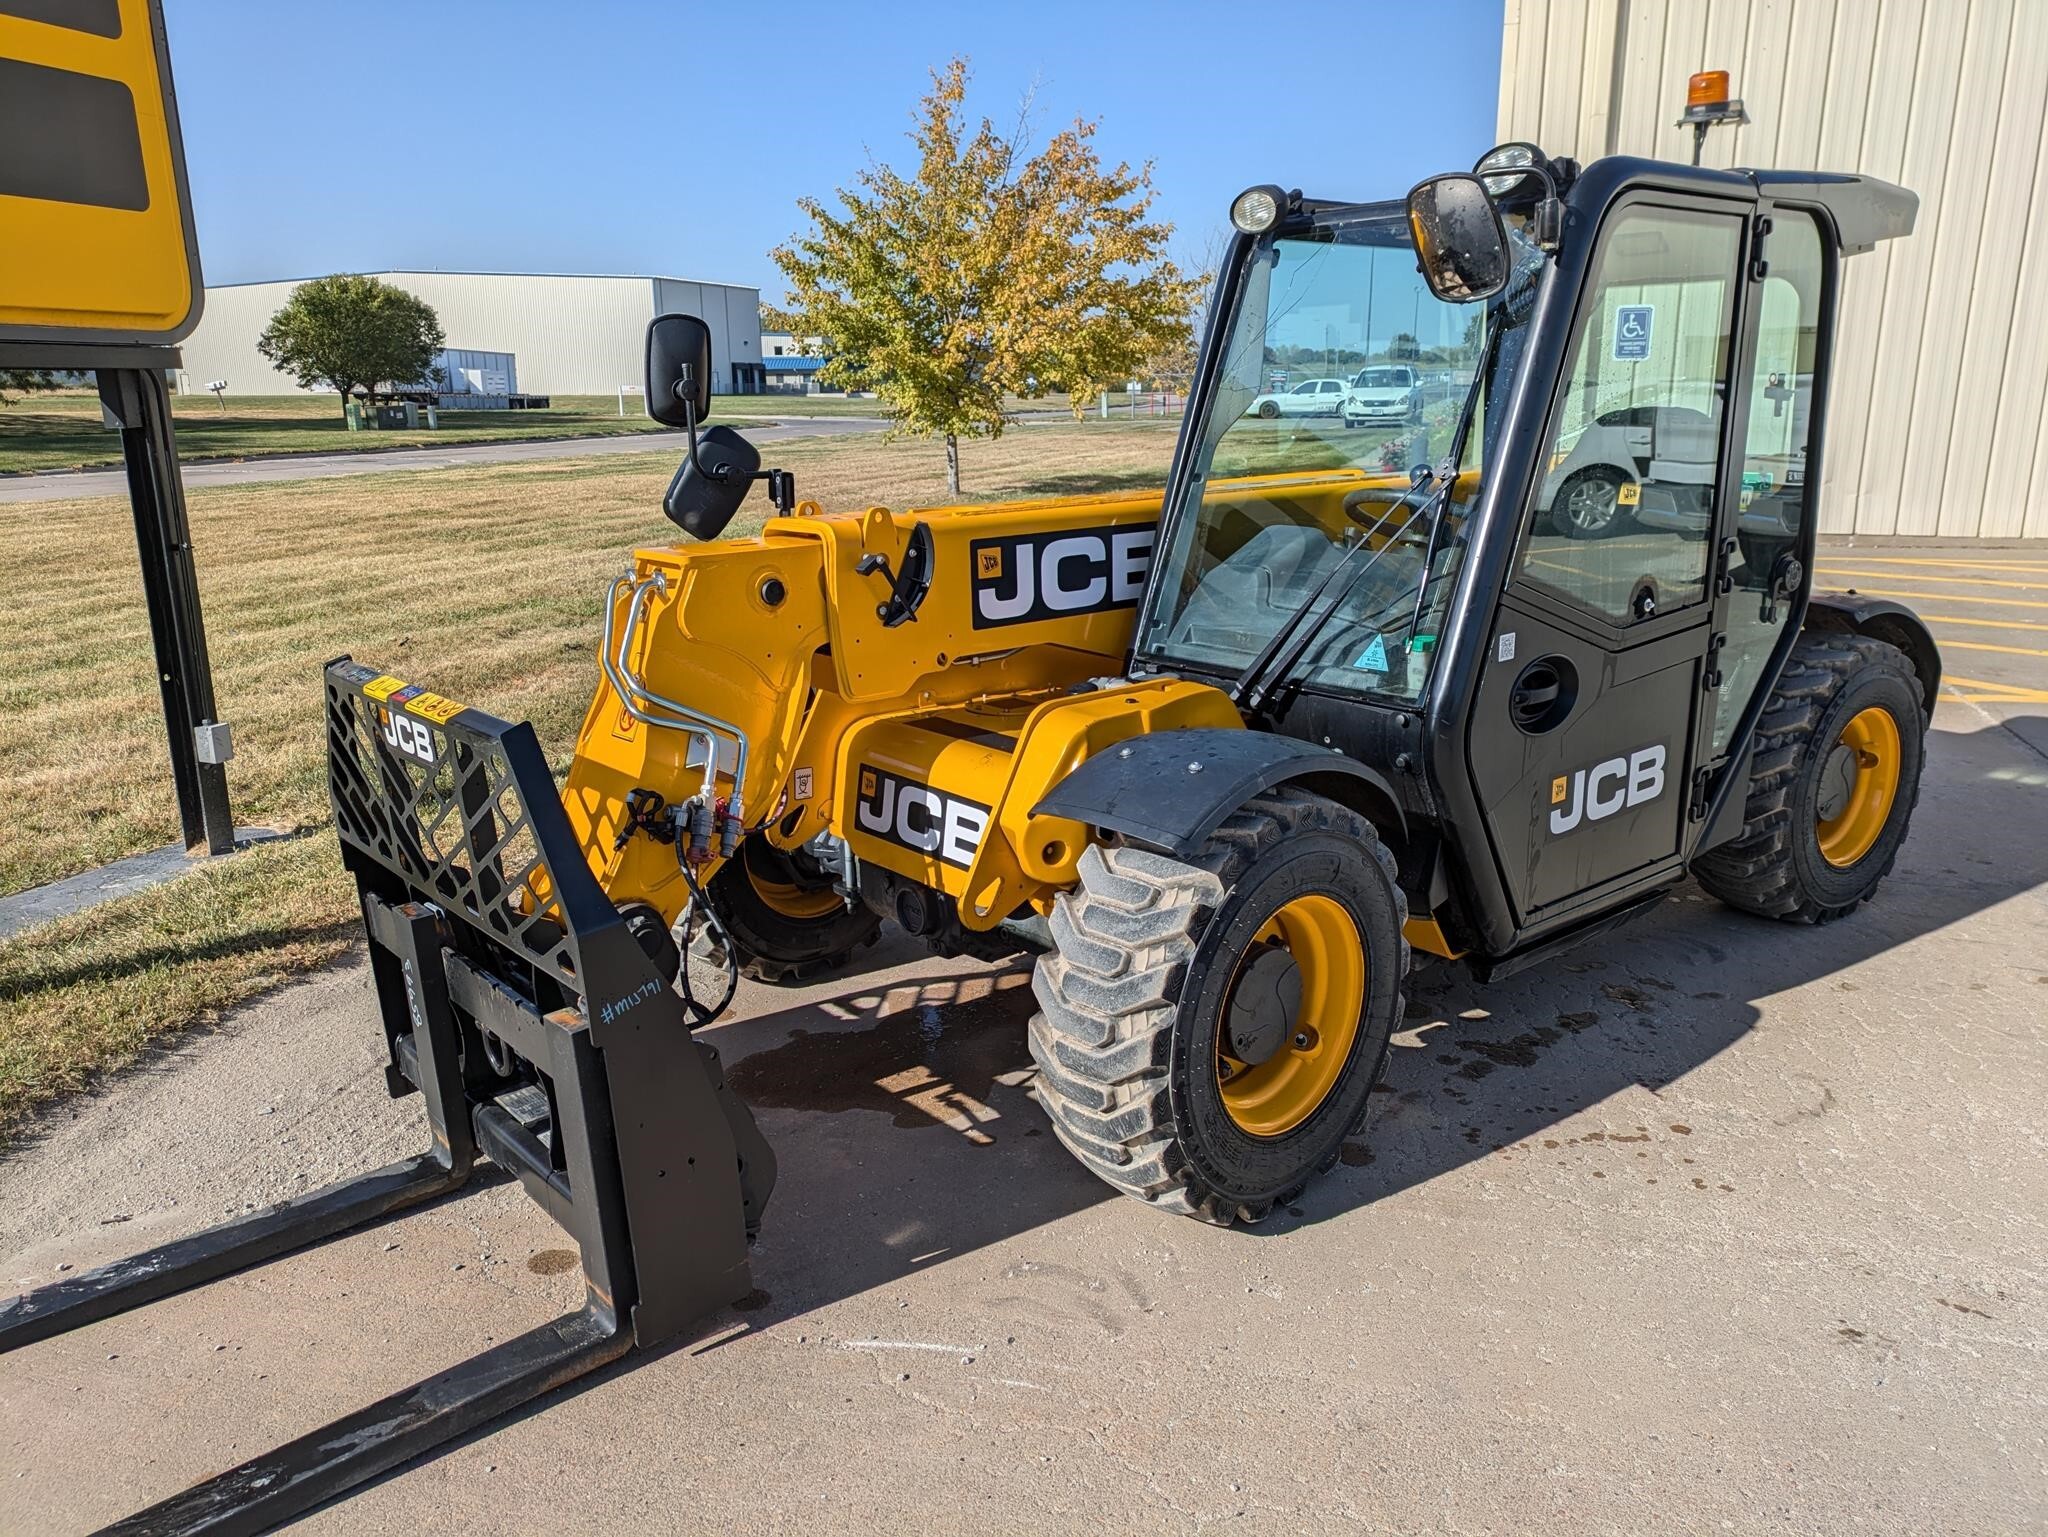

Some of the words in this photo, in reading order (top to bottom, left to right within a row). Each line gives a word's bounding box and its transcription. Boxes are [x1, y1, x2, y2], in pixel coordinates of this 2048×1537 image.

[983, 555, 999, 571] JCB
[384, 711, 434, 763] JCB
[860, 778, 990, 866] JCB
[1550, 744, 1666, 835] JCB
